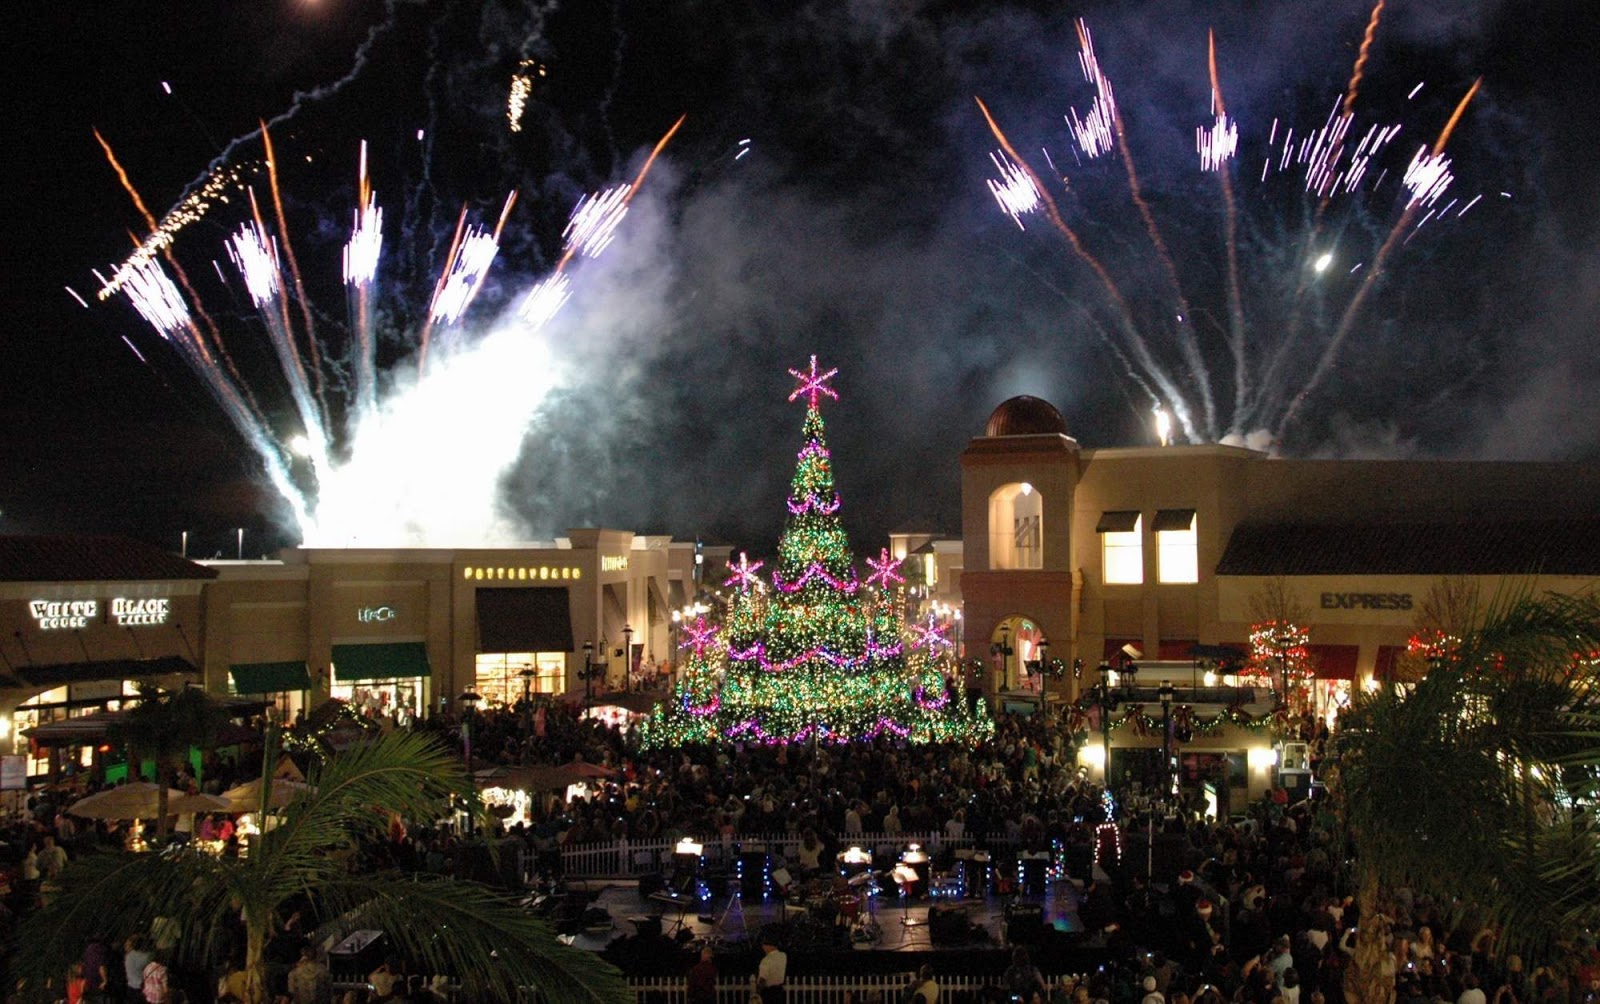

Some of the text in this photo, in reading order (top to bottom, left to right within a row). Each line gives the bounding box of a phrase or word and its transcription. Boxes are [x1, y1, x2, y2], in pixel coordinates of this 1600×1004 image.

[29, 597, 169, 618] WHITE BLACK
[1320, 592, 1413, 610] EXPRESS
